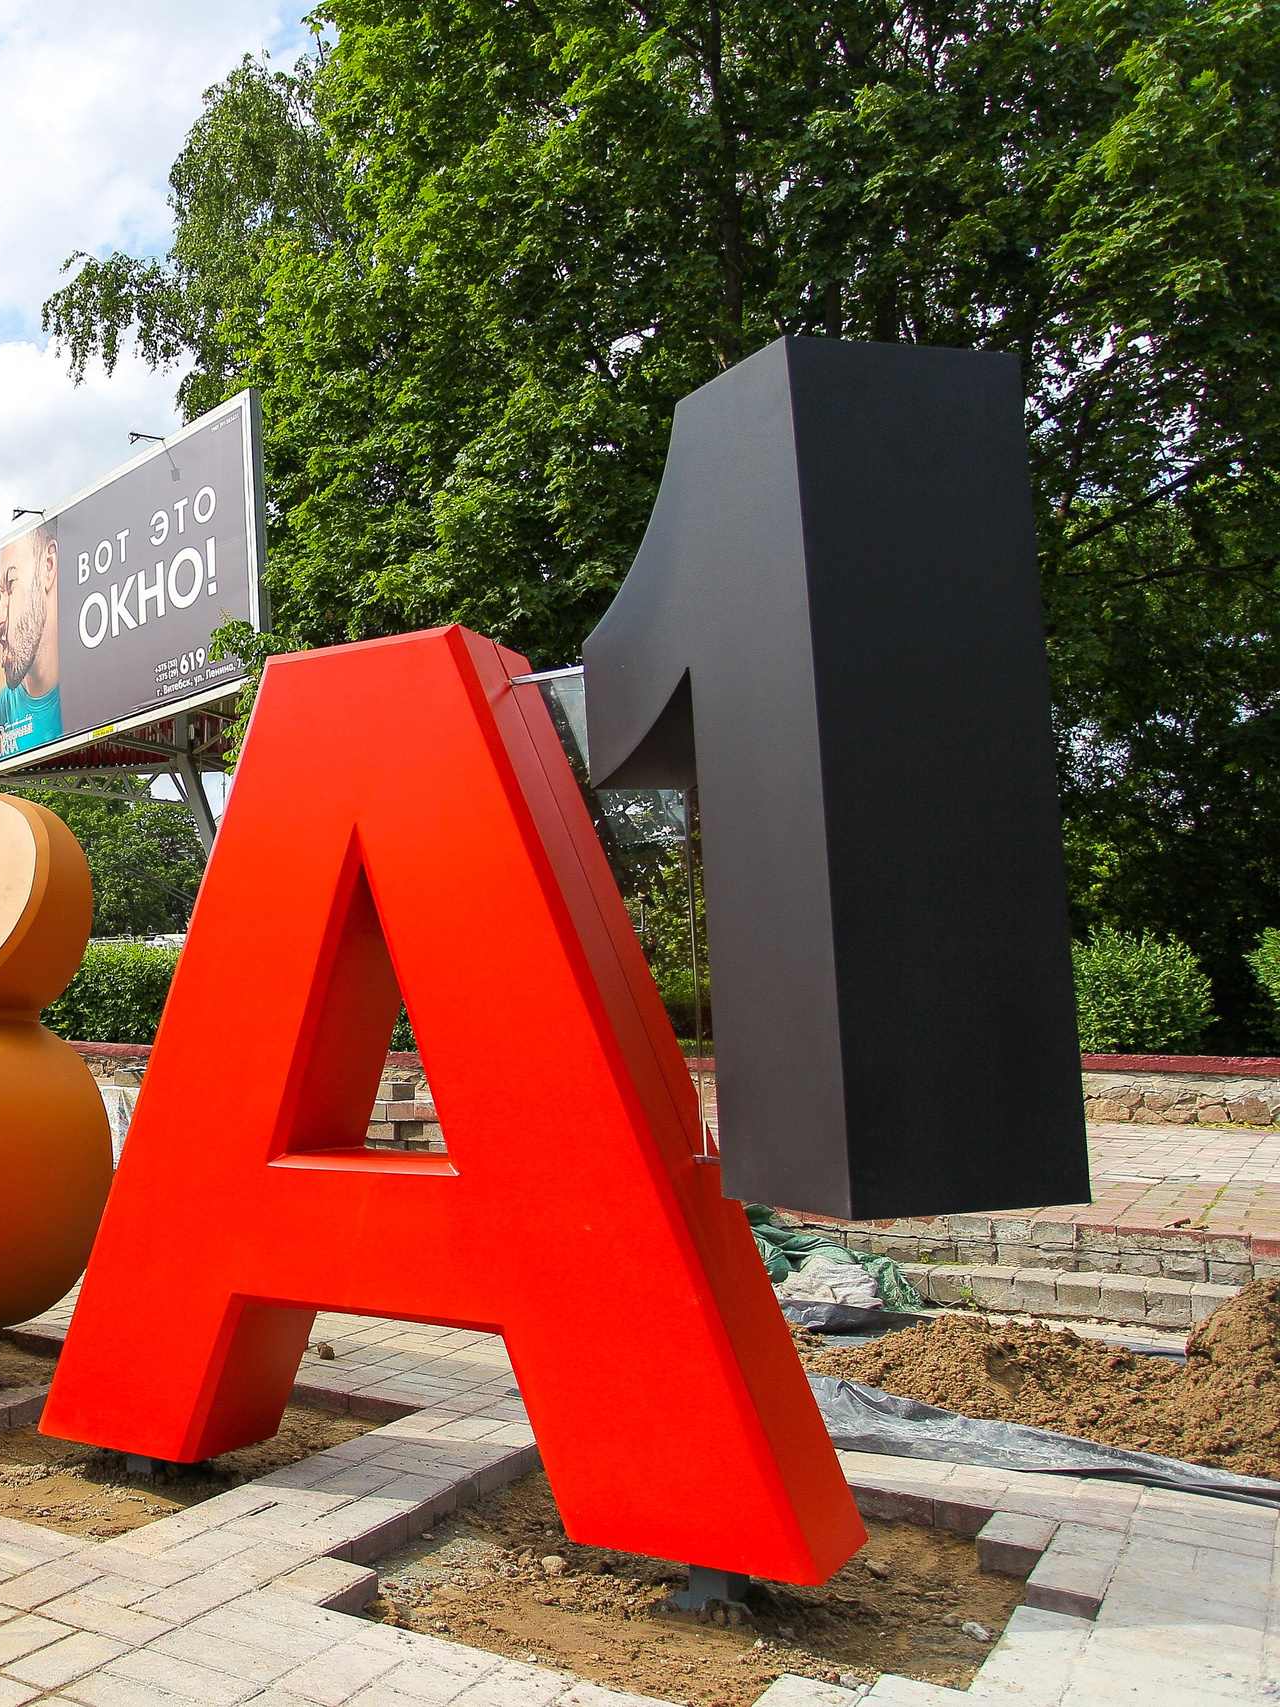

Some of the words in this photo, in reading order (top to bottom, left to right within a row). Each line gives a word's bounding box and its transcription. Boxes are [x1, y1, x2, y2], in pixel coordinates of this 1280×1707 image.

[77, 528, 130, 585] ВОТ
[149, 485, 217, 547] ЭТО
[78, 536, 218, 649] ОКНО!
[154, 663, 167, 673] +375
[180, 647, 206, 675] 619
[155, 673, 168, 683] +375
[163, 678, 193, 695] Витебск,
[193, 675, 205, 686] ул.
[205, 663, 236, 681] Ленина,
